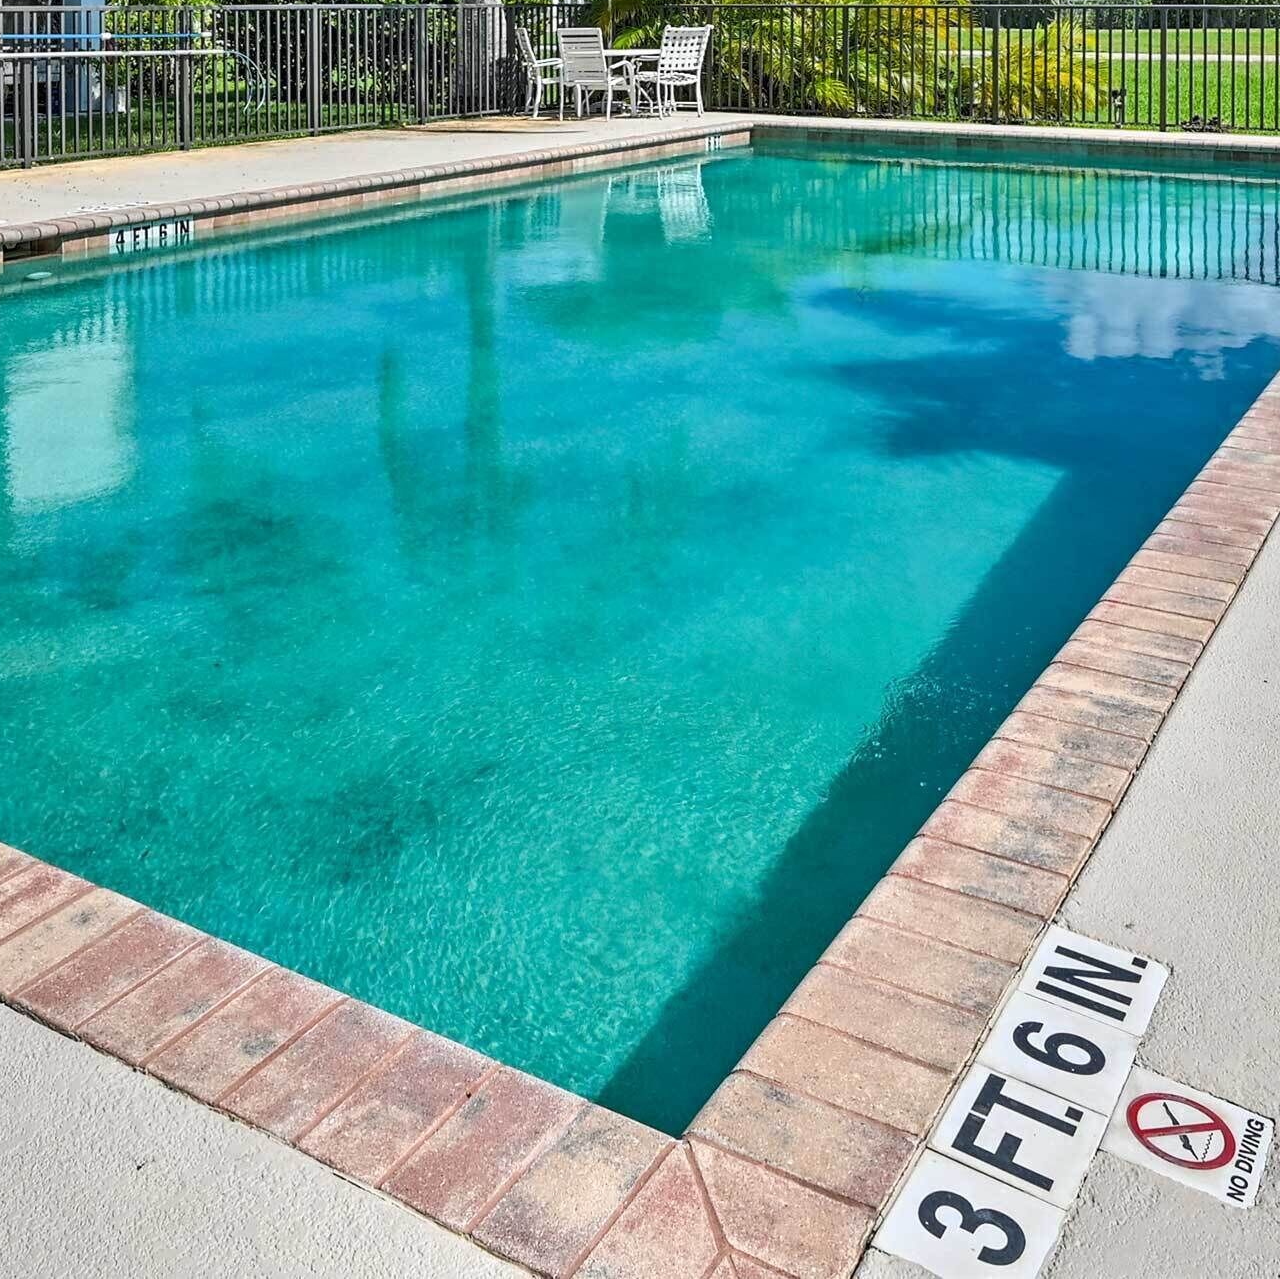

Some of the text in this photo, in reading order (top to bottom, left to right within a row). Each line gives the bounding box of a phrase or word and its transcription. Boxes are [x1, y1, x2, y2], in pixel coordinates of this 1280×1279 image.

[115, 219, 190, 244] 4 FT 6 IN
[917, 944, 1148, 1266] 3 FT. 6 IN.
[1226, 1118, 1265, 1202] NO DIVING
